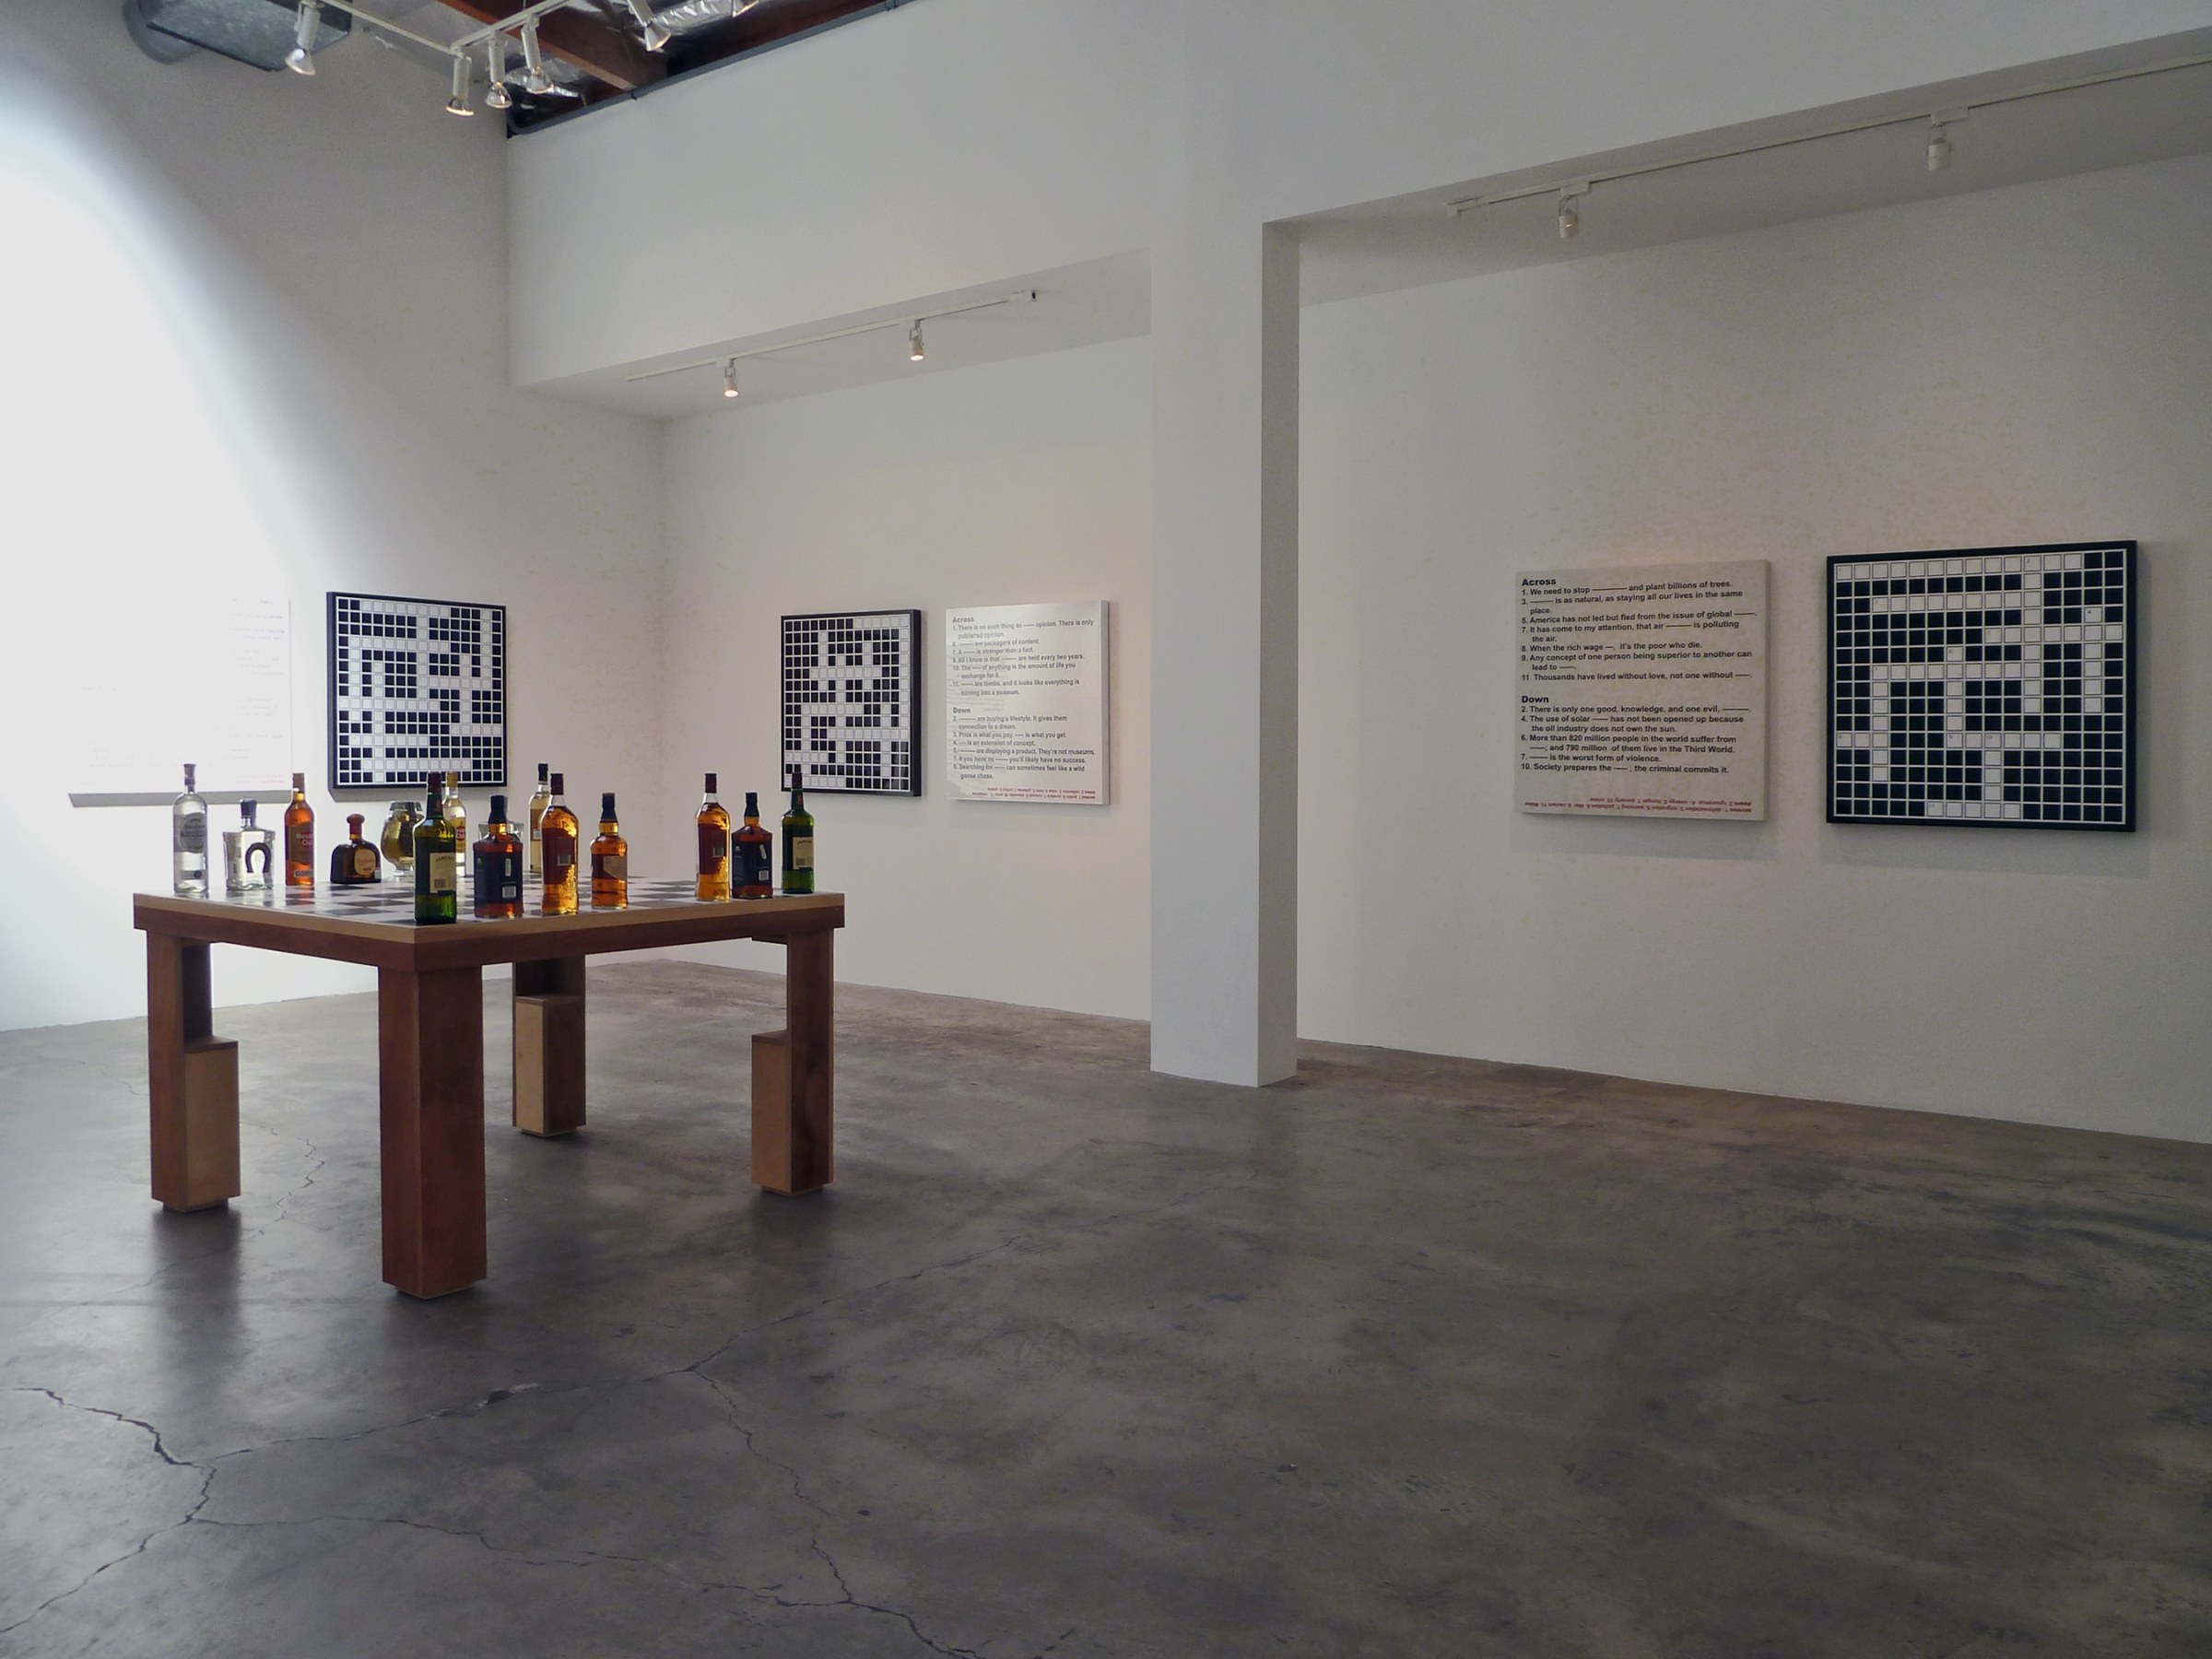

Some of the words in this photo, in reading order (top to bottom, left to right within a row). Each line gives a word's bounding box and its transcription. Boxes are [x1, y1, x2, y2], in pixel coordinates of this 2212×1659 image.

[1521, 577, 1556, 586] Across
[1572, 586, 1590, 594] stop
[1645, 582, 1666, 592] plant
[1616, 594, 1645, 603] staying
[1706, 609, 1732, 619] global
[1702, 619, 1739, 629] polluting
[1557, 724, 1588, 733] industry
[1612, 735, 1639, 743] people
[1716, 735, 1735, 743] from
[1533, 762, 1561, 771] Society
